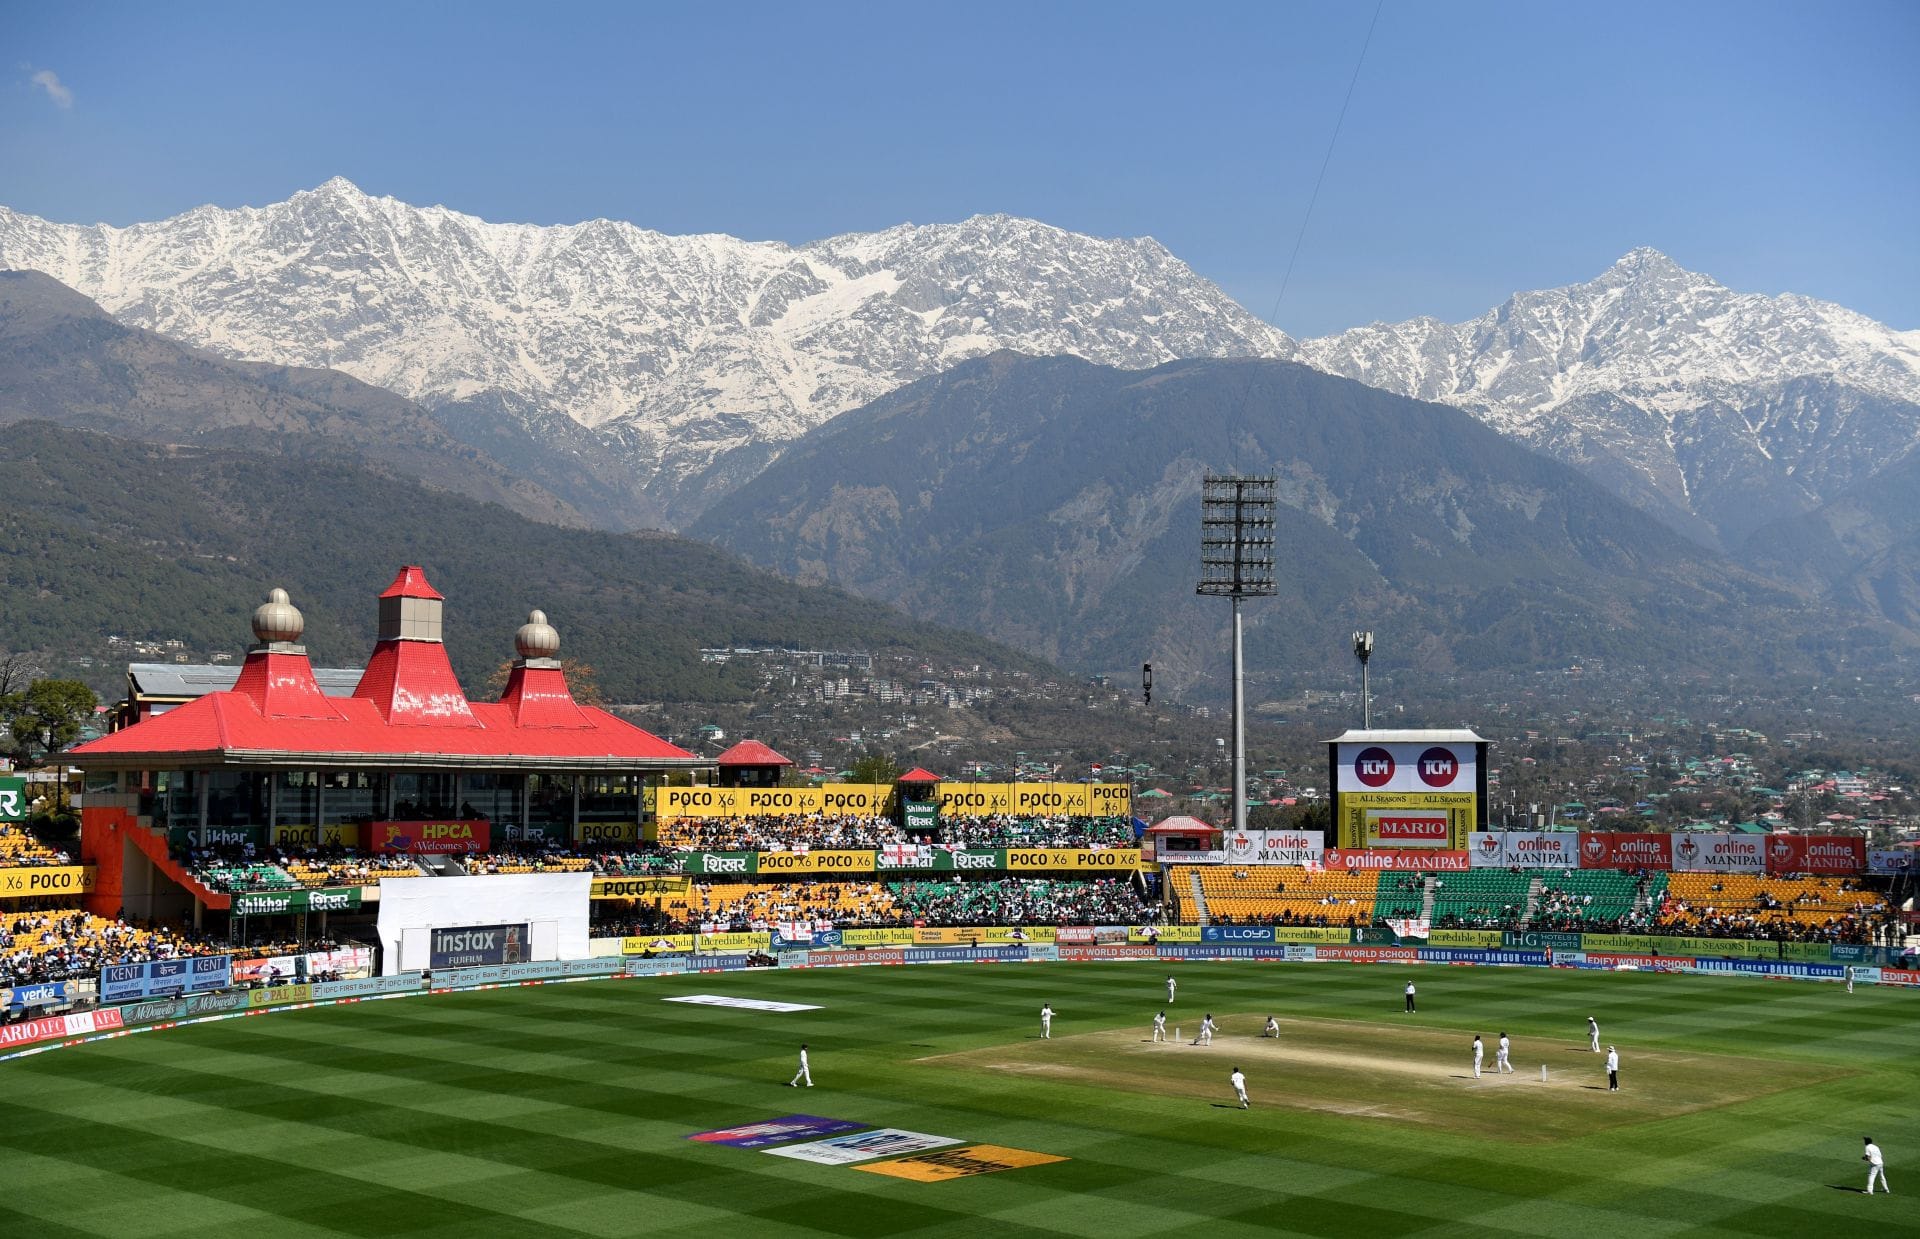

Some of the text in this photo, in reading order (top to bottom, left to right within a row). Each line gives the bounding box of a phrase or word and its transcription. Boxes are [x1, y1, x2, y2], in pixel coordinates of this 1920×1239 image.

[1361, 759, 1389, 775] TCM
[1424, 759, 1452, 775] TCM
[670, 792, 735, 806] POCO X6
[1094, 788, 1128, 798] POCO
[750, 793, 815, 806] POCO X6
[824, 794, 888, 808] POCO X6
[943, 794, 1007, 806] POCO X6
[1020, 794, 1084, 806] POCO X6
[906, 804, 934, 812] Shikhar
[422, 824, 472, 838] HPCA
[582, 826, 622, 838] POCO
[1382, 822, 1445, 834] MARIO
[326, 830, 341, 842] X6
[1268, 835, 1308, 848] online
[414, 840, 480, 850] Welcomes You
[1518, 837, 1560, 850] online
[1620, 839, 1660, 853] online
[1714, 840, 1756, 854] online
[1808, 842, 1852, 856] online
[952, 852, 996, 868] शिखर
[1010, 854, 1067, 866] POCO X6
[1078, 854, 1136, 866] POCO X6
[1257, 850, 1318, 860] MANIPAL
[1346, 852, 1468, 869] online MANIPAL
[1506, 852, 1572, 864] MANIPAL
[1610, 854, 1671, 864] MANIPAL
[1704, 855, 1766, 866] MANIPAL
[702, 853, 748, 872] शिखर
[758, 856, 812, 868] POCO X6
[818, 856, 871, 867] POCO X6
[1799, 858, 1864, 869] MANIPAL
[6, 874, 92, 890] X6 POCO X6
[604, 882, 668, 896] POCO X6
[236, 896, 292, 916] Shikhar
[844, 932, 888, 942] Incredible
[1224, 930, 1270, 938] LLOYD
[1276, 929, 1324, 938] Incredible
[436, 930, 494, 952] instax
[700, 934, 746, 946] Incredible
[1505, 934, 1536, 946] IHG
[1584, 936, 1633, 948] Incredible
[1680, 941, 1744, 950] ALL SEASONS
[904, 949, 936, 960] BANGUR
[966, 948, 998, 958] BANGUR
[1060, 948, 1084, 957] EDIFY
[1086, 948, 1118, 956] WORLD
[1120, 948, 1154, 956] SCHOOL
[1156, 947, 1188, 956] BANGUR
[1220, 947, 1253, 956] BANGUR
[1316, 949, 1415, 958] EDIFY WORLD SCHOOL
[1748, 944, 1800, 955] Increible
[1832, 944, 1859, 954] instax
[448, 955, 482, 964] FUJIFILM
[810, 955, 833, 963] EDIFY
[836, 954, 865, 962] WORLD
[868, 952, 902, 961] SCHOOL
[1418, 950, 1452, 960] BANGUR
[1486, 952, 1520, 962] BANGUR
[1588, 956, 1614, 966] EDIFY
[1616, 958, 1652, 967] WORLD
[1656, 959, 1692, 968] SCHOOL
[196, 958, 222, 971] KENT
[670, 960, 684, 968] Bank
[1696, 960, 1733, 970] BANGUR
[1736, 964, 1768, 972] CEMENT
[1770, 964, 1808, 975] BANGUR
[1810, 967, 1843, 976] CEMENT
[111, 966, 138, 981] KENT
[160, 965, 177, 976] केन्ट
[402, 978, 420, 986] FIRST
[1882, 972, 1912, 982] EDIFY
[22, 987, 54, 1000] verka
[96, 1010, 118, 1026] AFC
[39, 1019, 64, 1036] AFC
